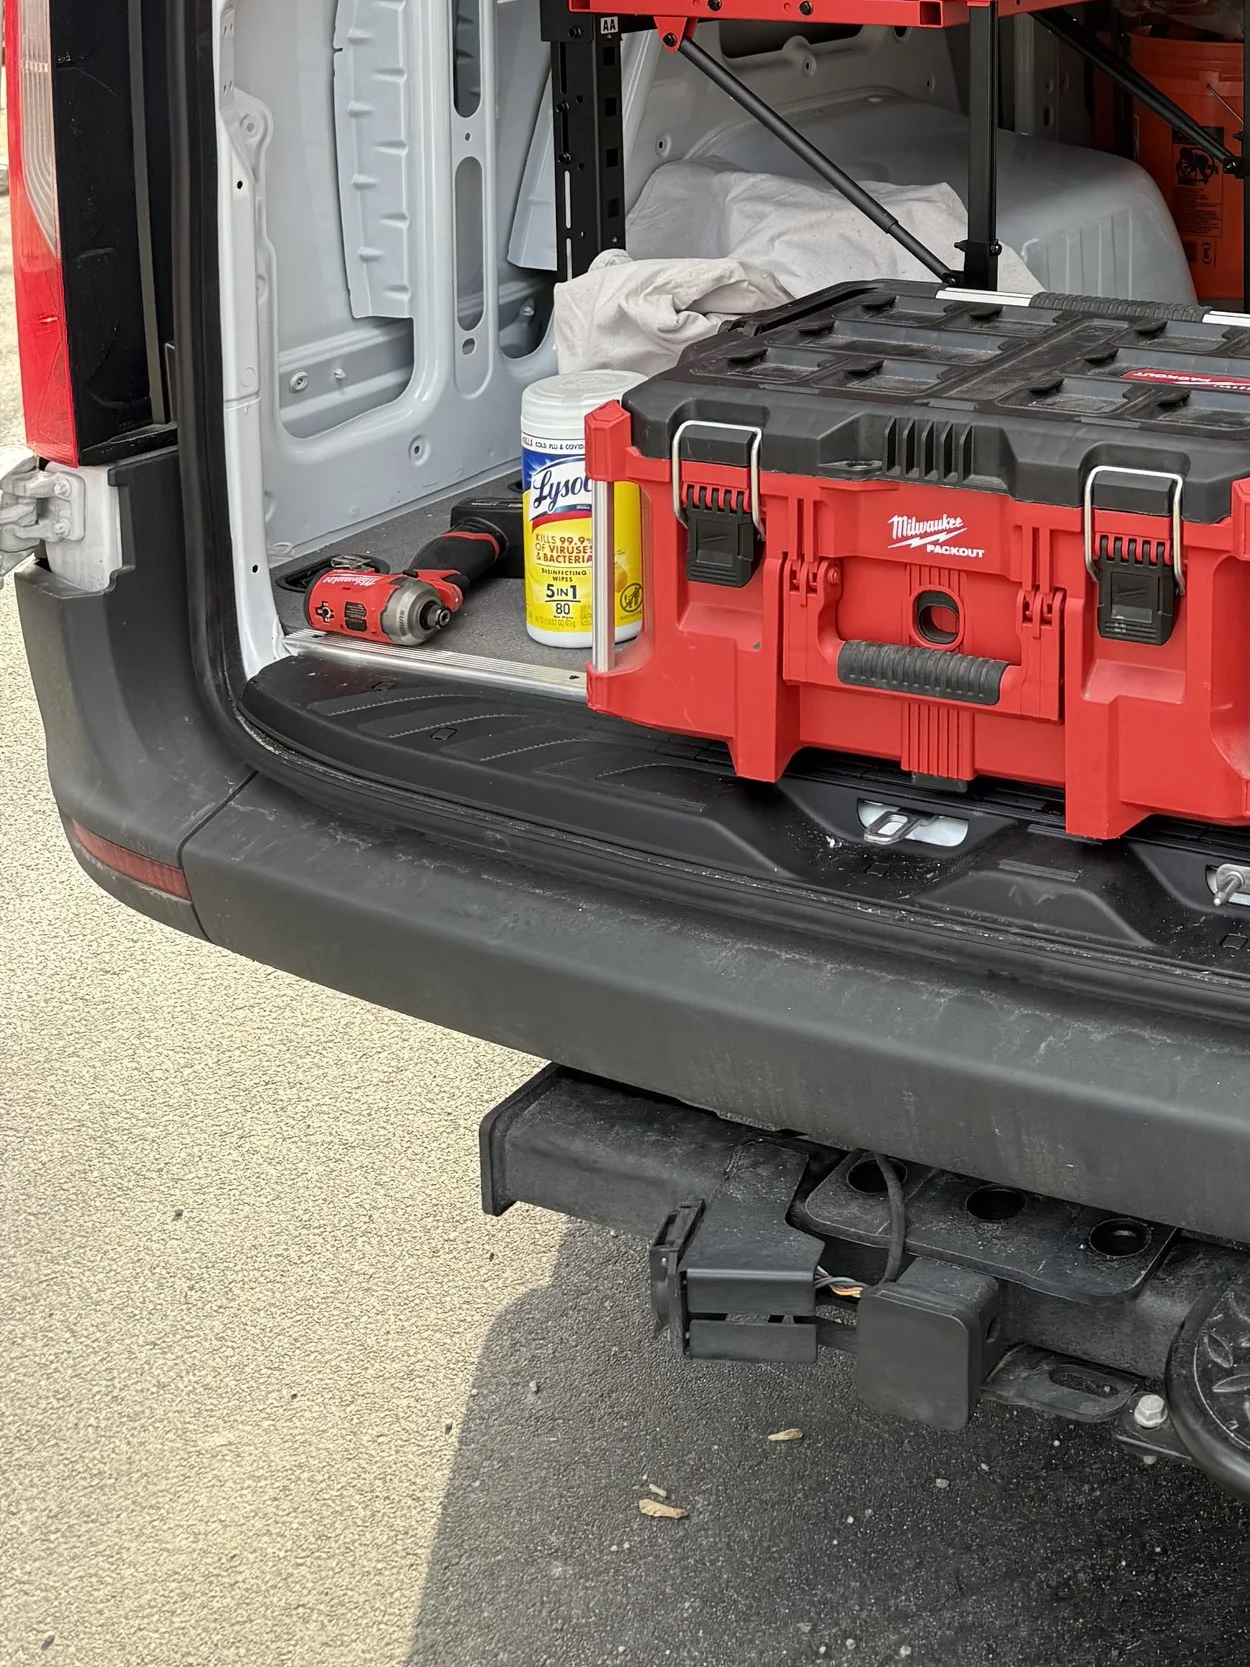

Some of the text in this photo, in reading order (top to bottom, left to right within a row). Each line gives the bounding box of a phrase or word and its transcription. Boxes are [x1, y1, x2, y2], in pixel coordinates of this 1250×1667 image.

[533, 470, 592, 512] Lysol
[888, 514, 964, 539] Milwaukee
[535, 534, 556, 544] KILLS
[535, 542, 546, 552] OF
[926, 544, 985, 558] PACKOUT
[536, 552, 592, 564] & BACTERIA
[541, 567, 587, 576] DISINFECTING
[546, 583, 577, 600] 5 IN 1
[555, 603, 571, 615] 80
